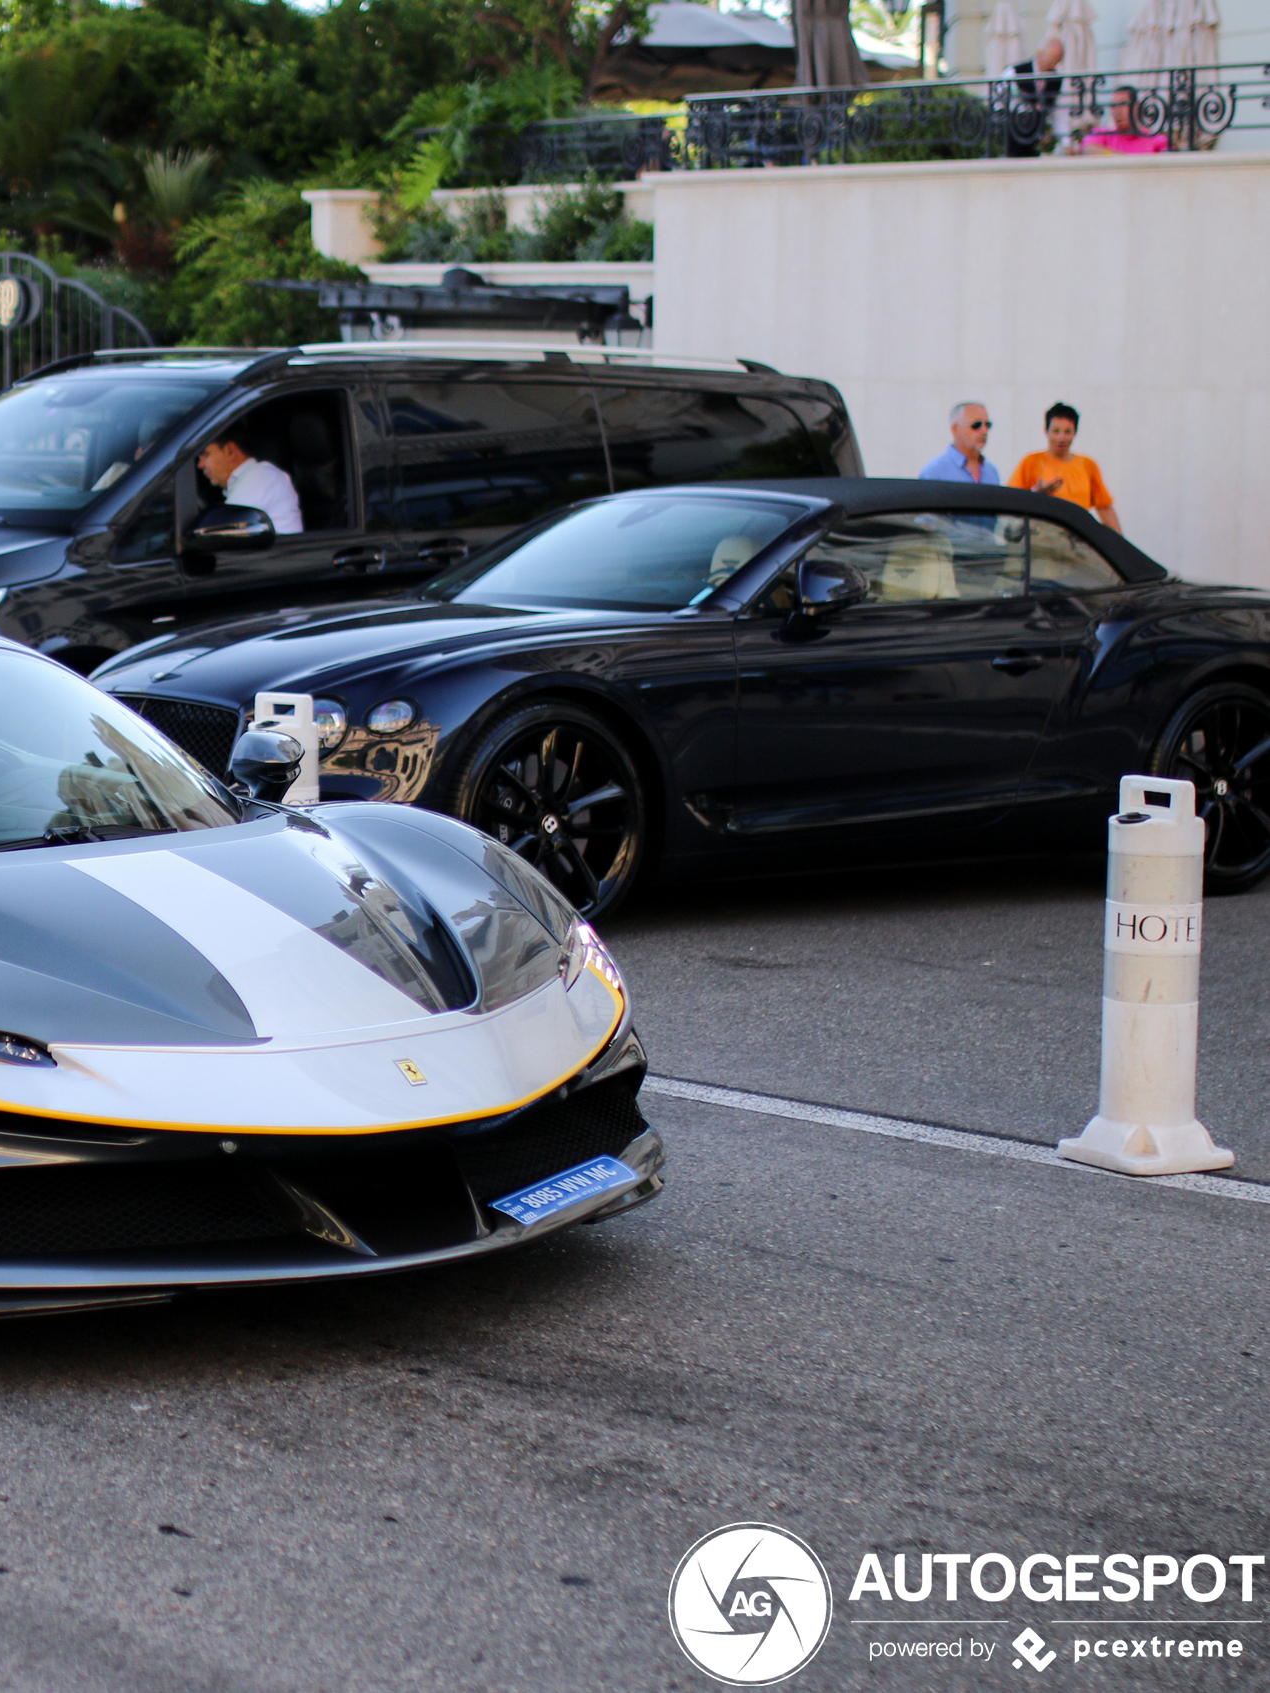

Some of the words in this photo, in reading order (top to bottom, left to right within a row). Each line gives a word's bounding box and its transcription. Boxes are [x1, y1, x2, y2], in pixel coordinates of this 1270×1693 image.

[520, 1186, 564, 1209] 8085
[552, 1173, 593, 1193] WW
[583, 1164, 617, 1182] MC
